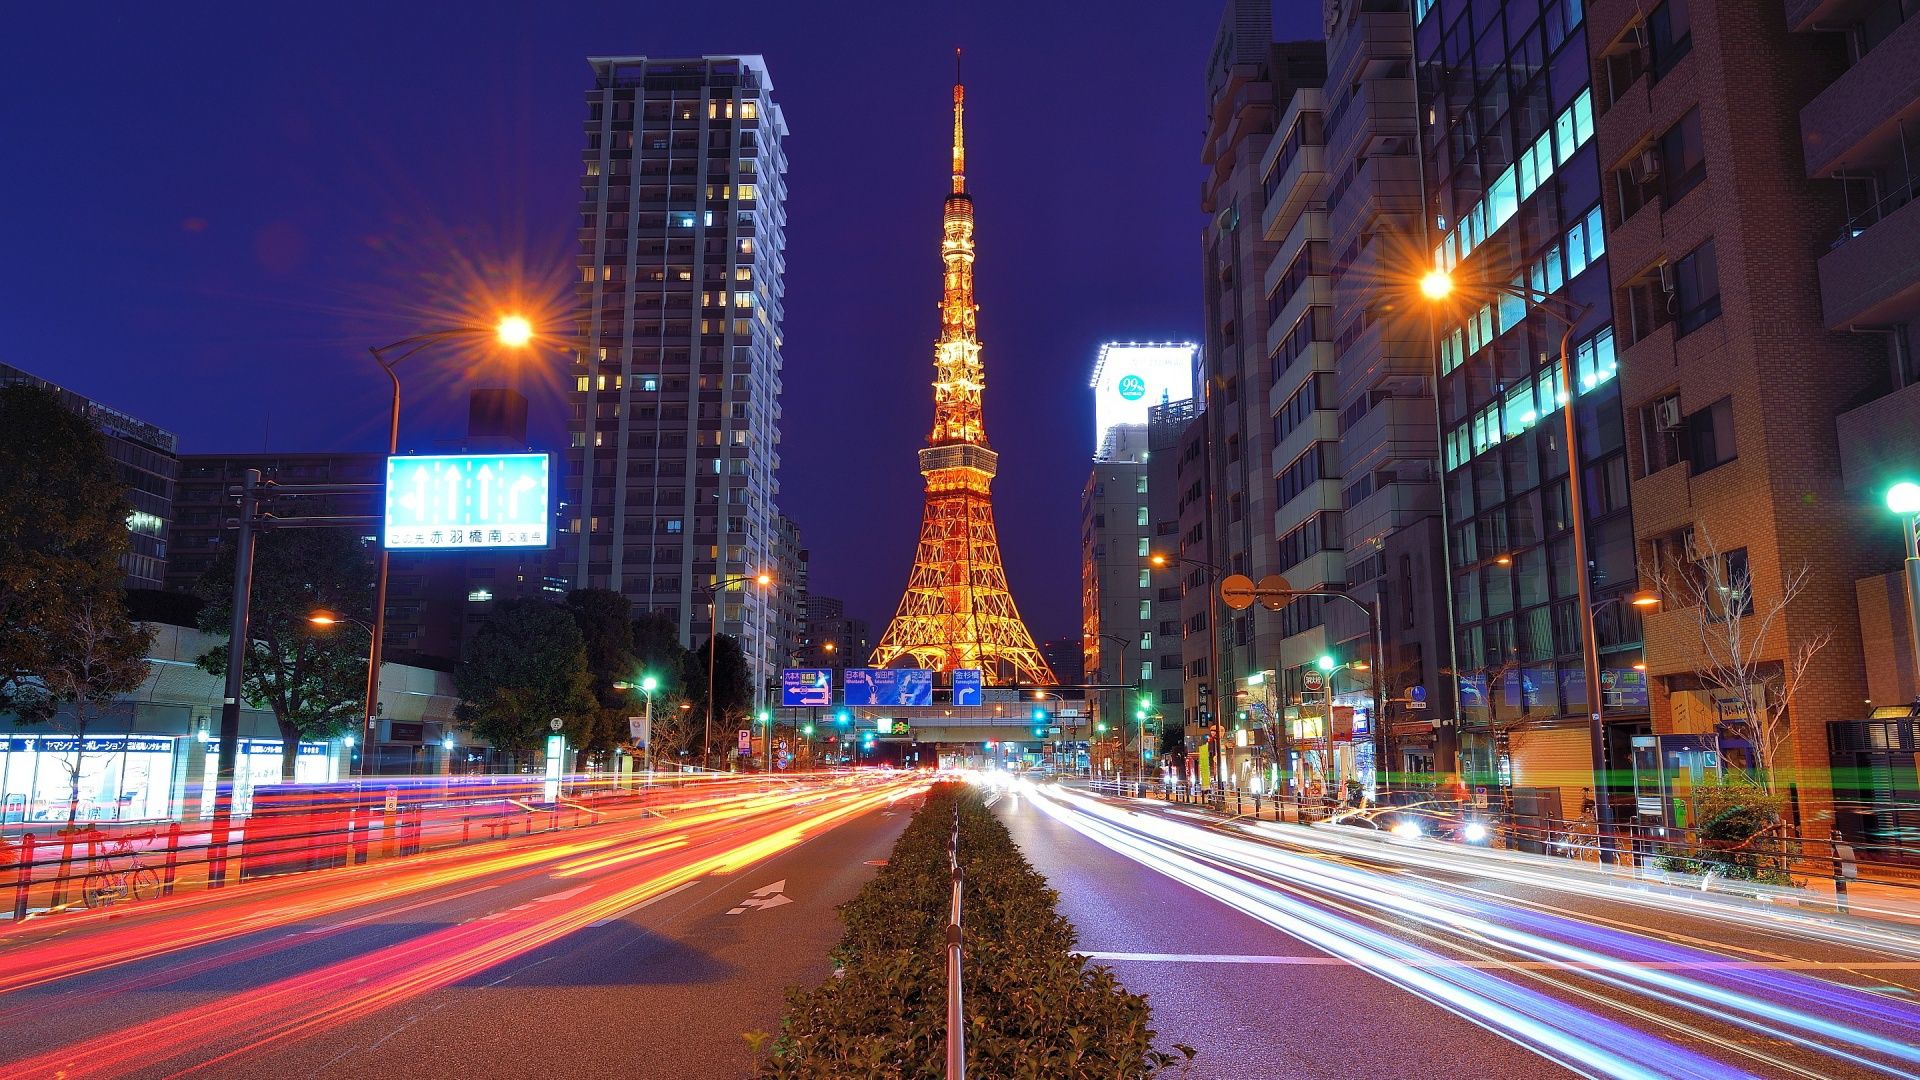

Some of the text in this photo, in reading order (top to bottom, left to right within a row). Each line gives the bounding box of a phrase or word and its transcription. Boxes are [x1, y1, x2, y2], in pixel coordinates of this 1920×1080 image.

[846, 671, 865, 679] 日本橋
[955, 670, 979, 680] 金杉橋
[740, 731, 748, 741] P
